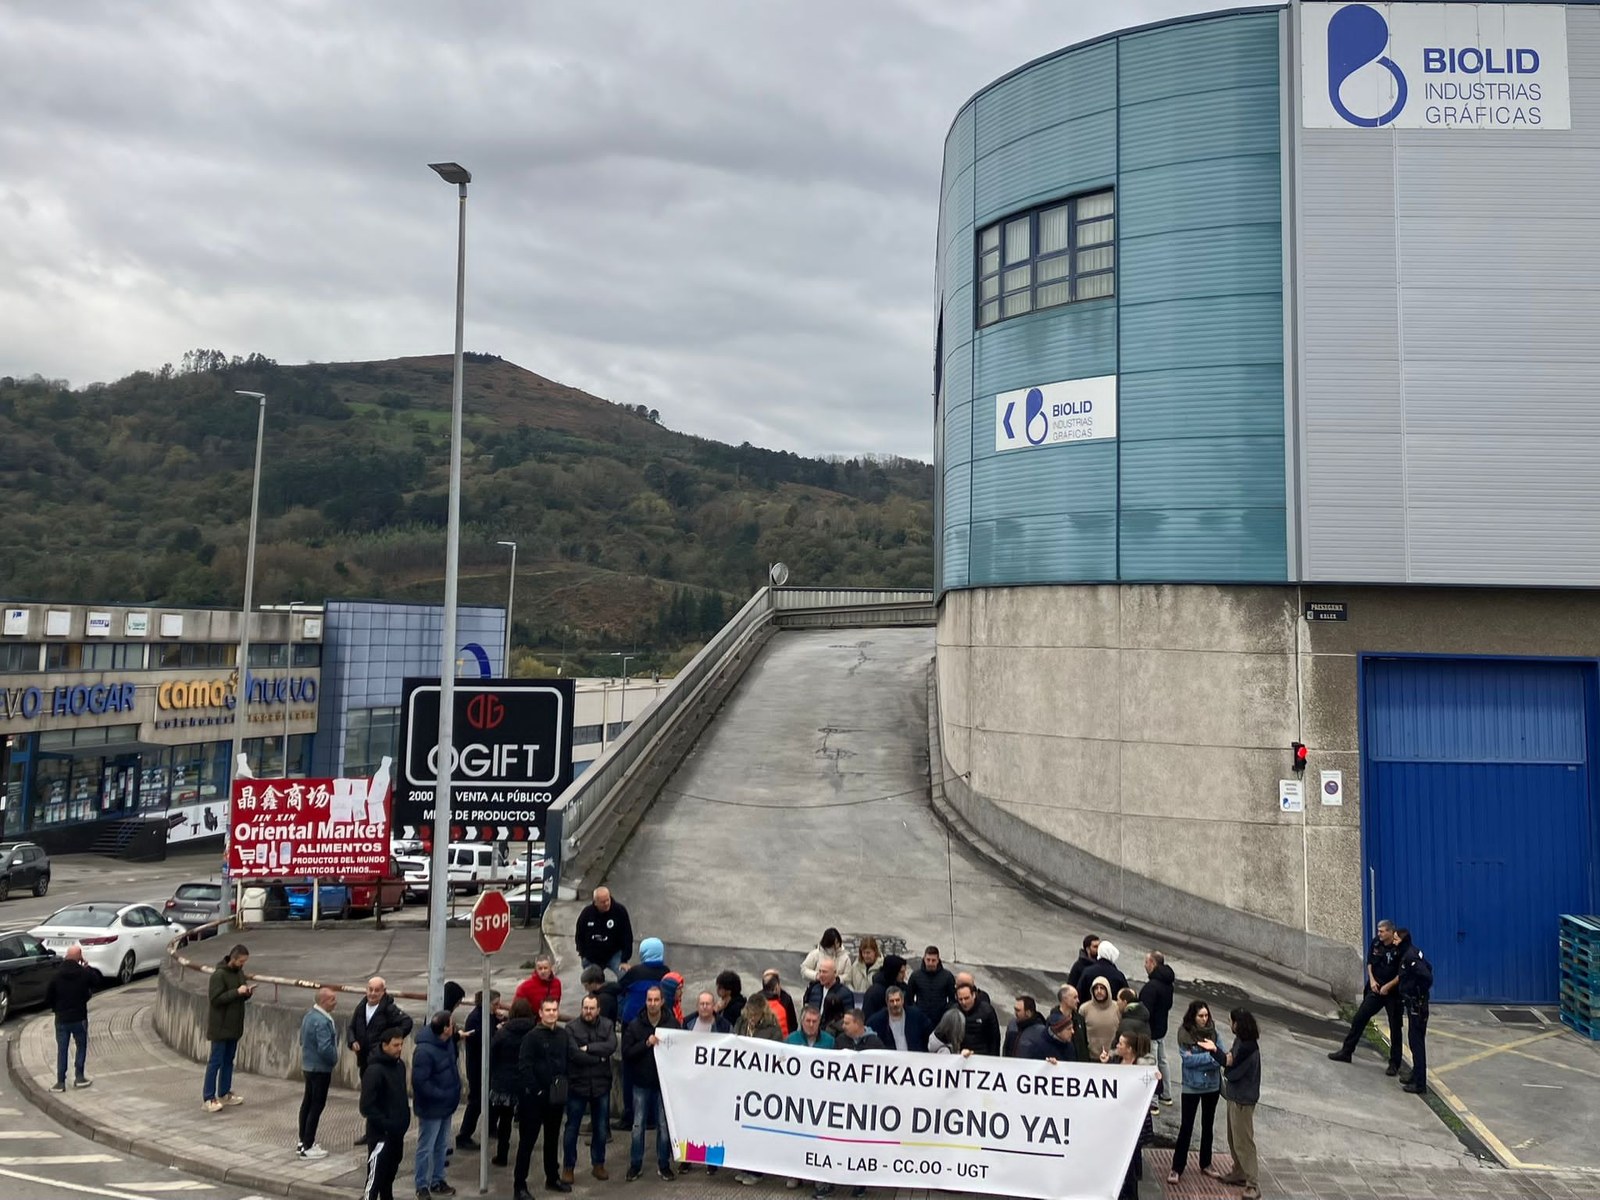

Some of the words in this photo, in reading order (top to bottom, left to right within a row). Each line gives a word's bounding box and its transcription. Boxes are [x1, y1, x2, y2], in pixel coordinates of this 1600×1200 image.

[1423, 47, 1540, 74] BIOLID
[1425, 82, 1541, 100] INDUSTRIAS
[1425, 103, 1541, 124] GRÁFICAS
[1052, 400, 1092, 417] BIOLID
[1053, 417, 1093, 430] INDUSTRIAS
[53, 682, 136, 717] HOGAR
[159, 679, 225, 710] cama
[237, 783, 330, 811] 晶鑫商场
[408, 791, 434, 801] 2000
[455, 791, 488, 802] VENTA
[491, 791, 504, 802] AL
[507, 789, 552, 803] PÚBLICO
[252, 813, 271, 823] JIN
[275, 813, 296, 822] XIN
[455, 810, 469, 820] DE
[471, 810, 536, 821] PRODUCTOS
[235, 822, 312, 841] Oriental
[317, 821, 385, 839] Market
[297, 843, 382, 853] ALIMENTOS
[294, 866, 335, 874] ASIATICOS
[340, 856, 355, 864] DEL
[475, 912, 508, 932] STOP
[694, 1046, 801, 1076] BIZKAIKO
[810, 1059, 1008, 1092] GRAFIKAGINTZA
[1016, 1074, 1118, 1099] GREBAN
[734, 1090, 902, 1132] ¡CONVENIO
[911, 1107, 1010, 1140] DIGNO
[1020, 1114, 1070, 1145] YA!
[805, 1151, 832, 1169] ELA
[847, 1157, 878, 1172] LAB
[893, 1159, 942, 1174] CC.OO
[957, 1163, 989, 1179] UGT
